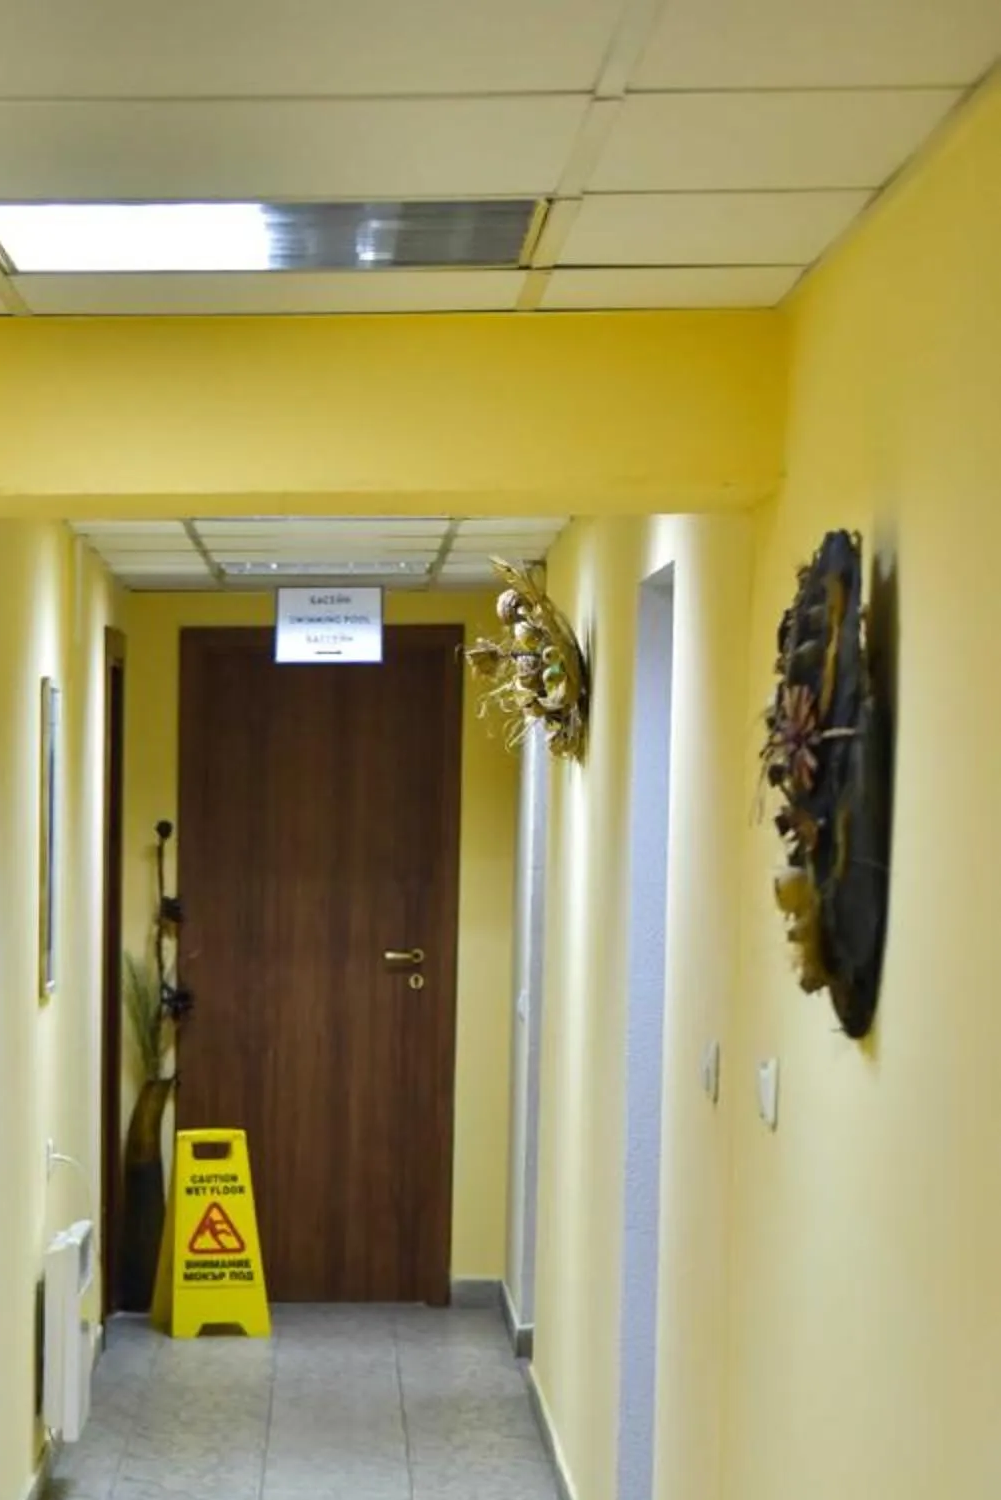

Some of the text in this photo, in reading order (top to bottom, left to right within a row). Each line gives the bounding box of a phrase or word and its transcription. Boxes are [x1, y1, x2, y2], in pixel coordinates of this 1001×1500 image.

[343, 614, 371, 625] POOL
[190, 1173, 238, 1184] CAUTION
[186, 1185, 245, 1196] WET FLOOR
[185, 1259, 251, 1269] ВНИМАНИЕ
[183, 1271, 253, 1281] МОКЪР ПОД
